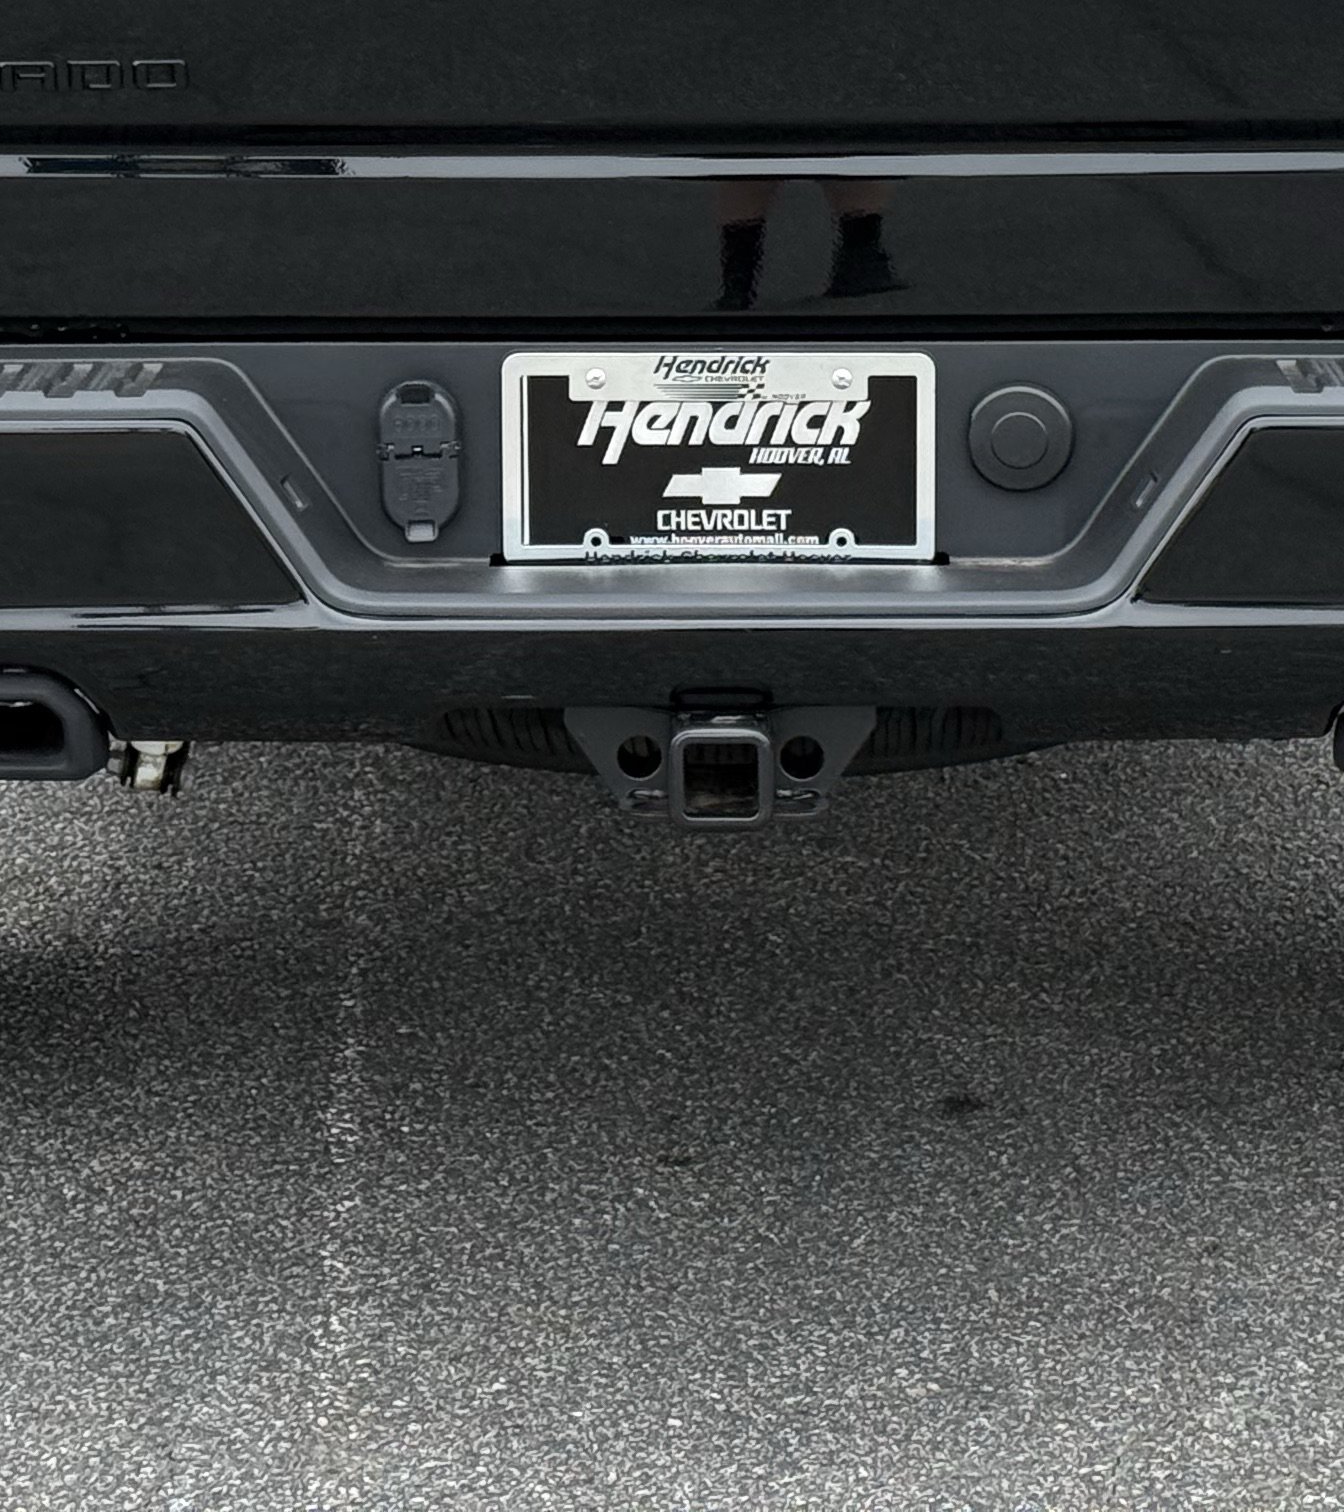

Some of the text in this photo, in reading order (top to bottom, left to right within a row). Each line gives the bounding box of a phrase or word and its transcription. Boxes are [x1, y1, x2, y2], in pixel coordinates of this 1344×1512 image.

[653, 355, 771, 380] Hendrick
[704, 375, 765, 383] CHEVROLET
[576, 400, 872, 464] Hendrick
[748, 446, 852, 467] HOOVER, AL
[656, 509, 792, 531] CHEVROLET
